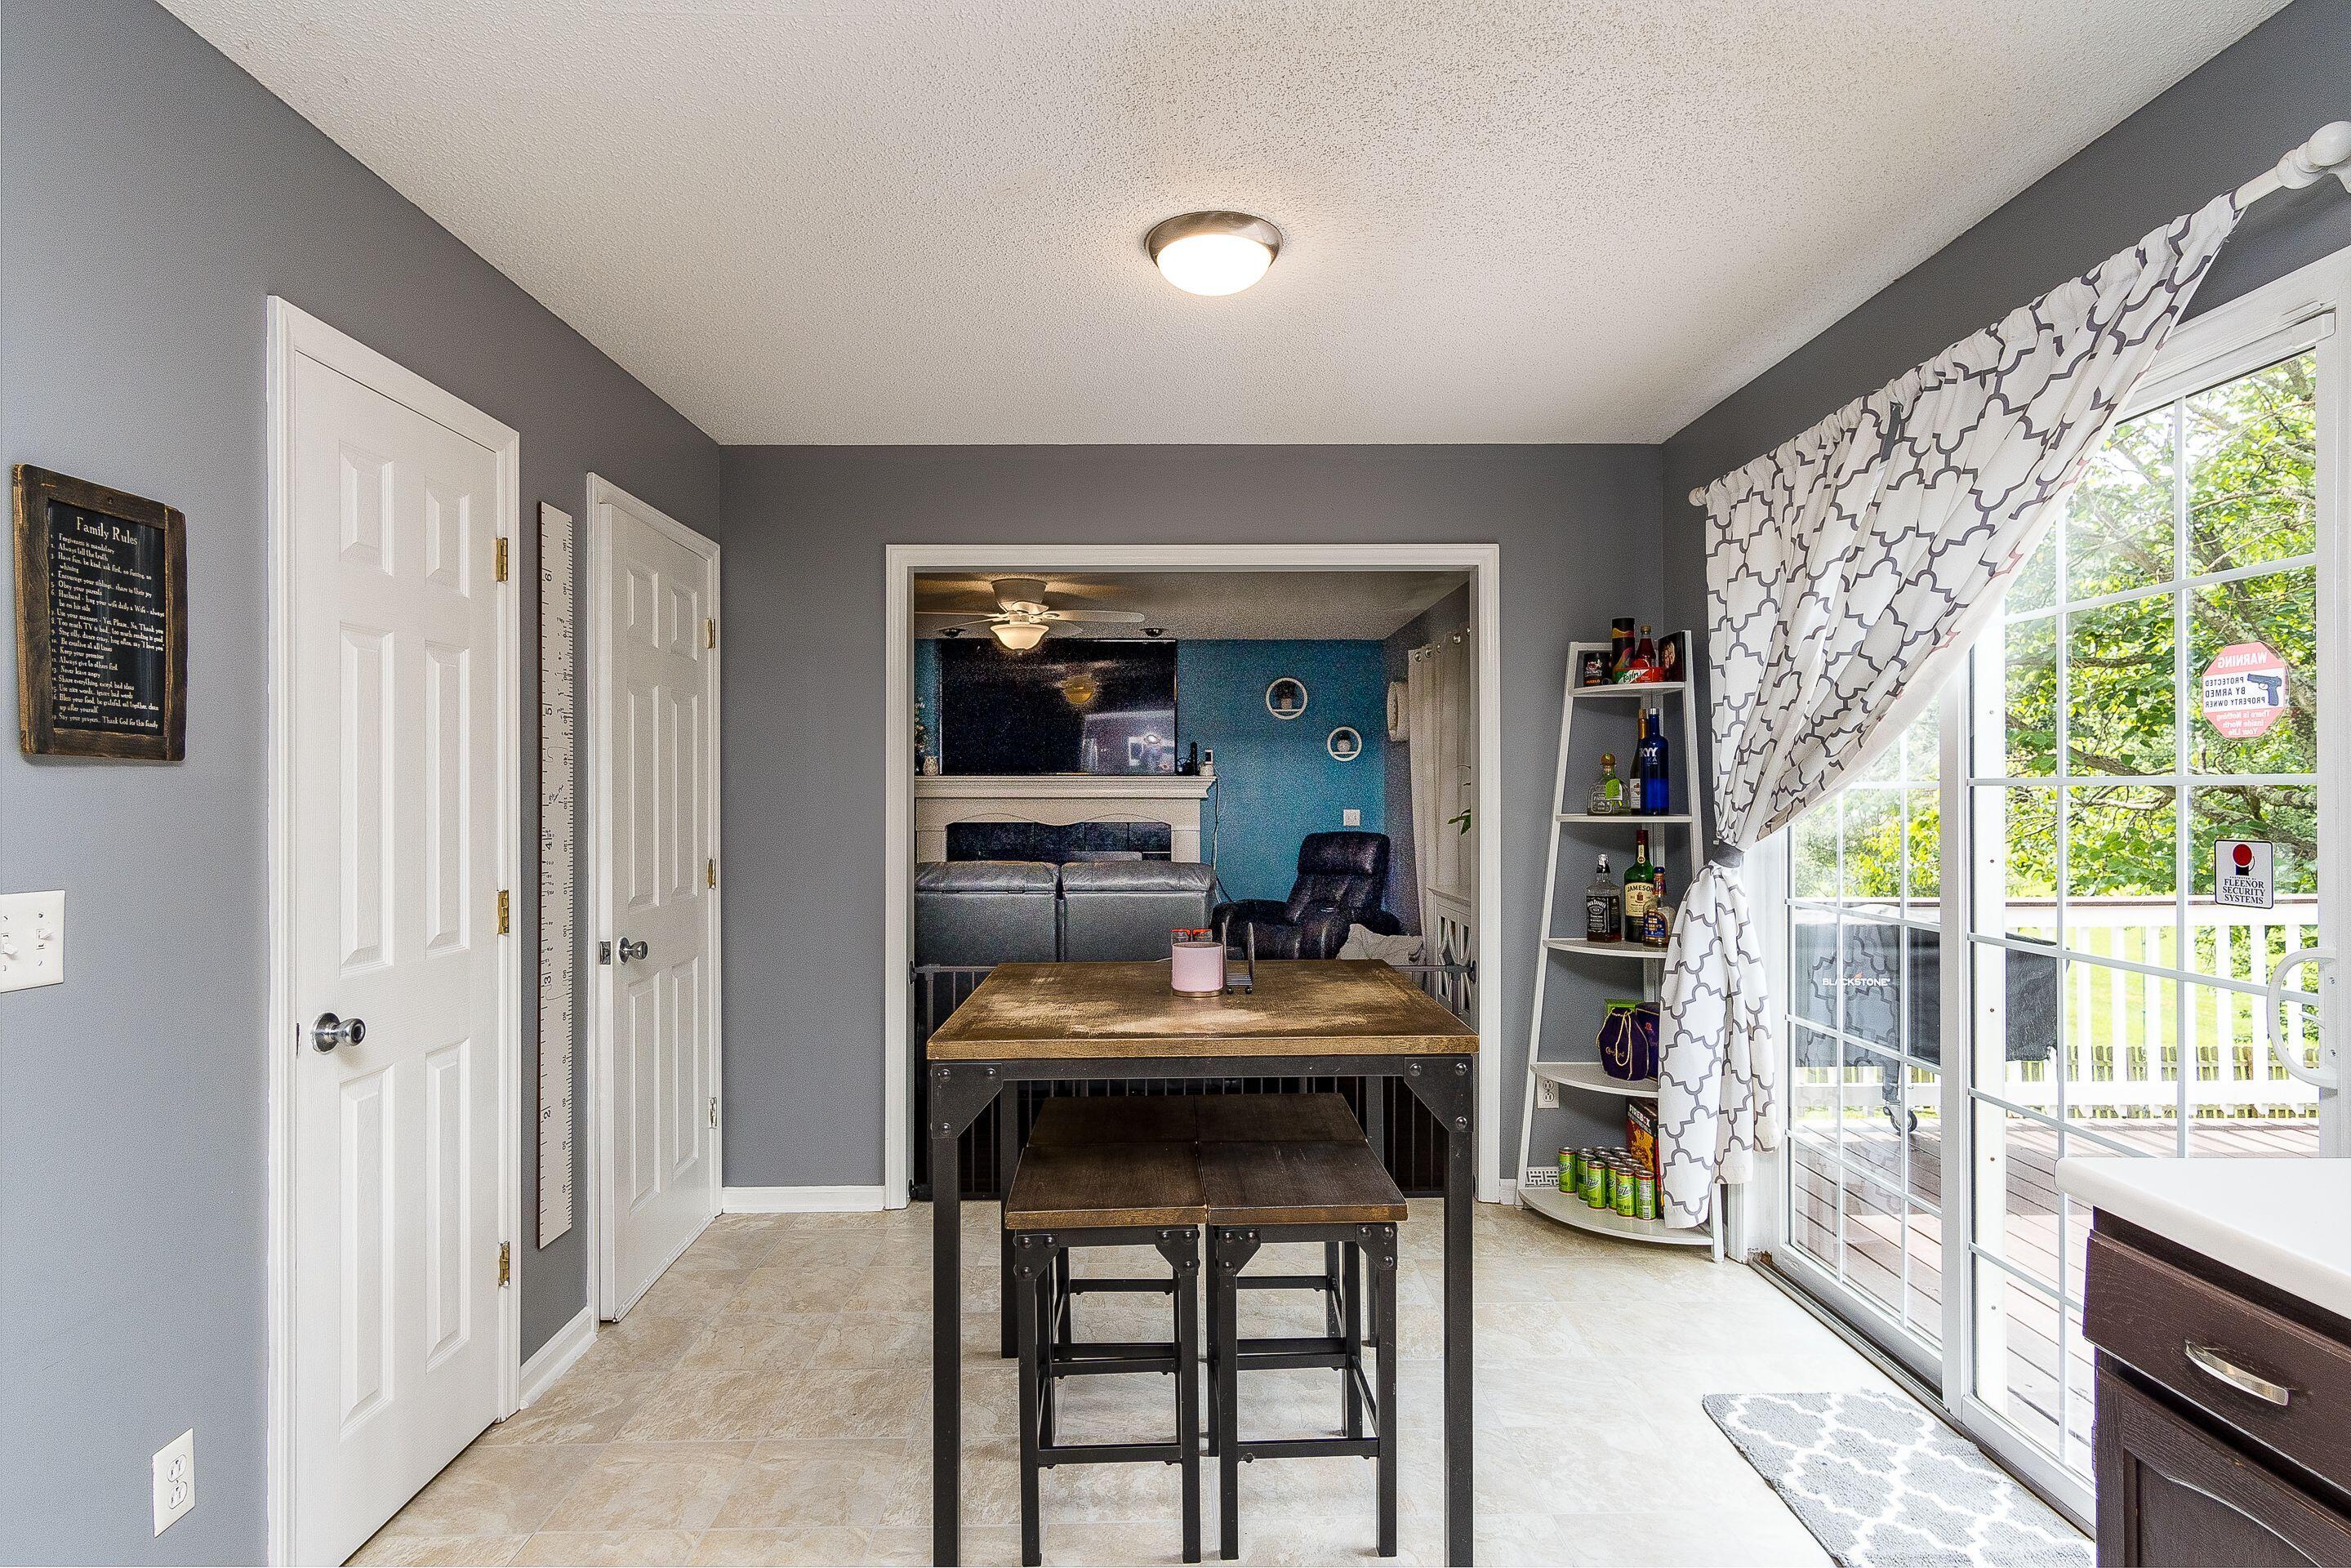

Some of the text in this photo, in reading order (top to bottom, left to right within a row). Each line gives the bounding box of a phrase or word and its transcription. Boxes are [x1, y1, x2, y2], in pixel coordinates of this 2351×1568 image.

[76, 517, 137, 545] Family Rules
[59, 533, 84, 546] Forgiveness
[91, 544, 114, 554] mandatory
[58, 543, 77, 554] Always
[77, 547, 85, 555] tell
[58, 551, 71, 561] Have
[60, 563, 78, 573] whining
[544, 572, 552, 581] 6
[58, 570, 82, 582] Encourage
[115, 583, 127, 591] share
[134, 587, 145, 595] their
[58, 580, 72, 590] Obey
[58, 590, 80, 600] Husband
[85, 595, 95, 604] hug
[118, 602, 129, 611] daily
[135, 605, 145, 613] Wife
[149, 608, 164, 617] always
[59, 599, 65, 607] be
[56, 617, 68, 626] Too
[133, 632, 148, 641] reading
[139, 623, 154, 632] Thank
[59, 627, 69, 636] Sing
[82, 631, 96, 639] dance
[110, 636, 119, 644] hug
[60, 646, 72, 656] Keep
[100, 644, 112, 652] times
[59, 656, 77, 666] Always
[109, 662, 118, 670] first
[60, 665, 73, 674] Never
[75, 666, 87, 675] leave
[58, 675, 73, 683] Share
[67, 703, 78, 711] after
[545, 707, 553, 716] 5
[59, 712, 68, 720] Say
[145, 719, 158, 728] family
[545, 841, 553, 850] 4
[2224, 879, 2264, 889] FLEENOR
[2222, 886, 2266, 897] SECURITY
[2224, 894, 2264, 904] SYSTEMS
[563, 969, 567, 979] 90
[543, 975, 552, 984] 3
[543, 1109, 551, 1120] 2
